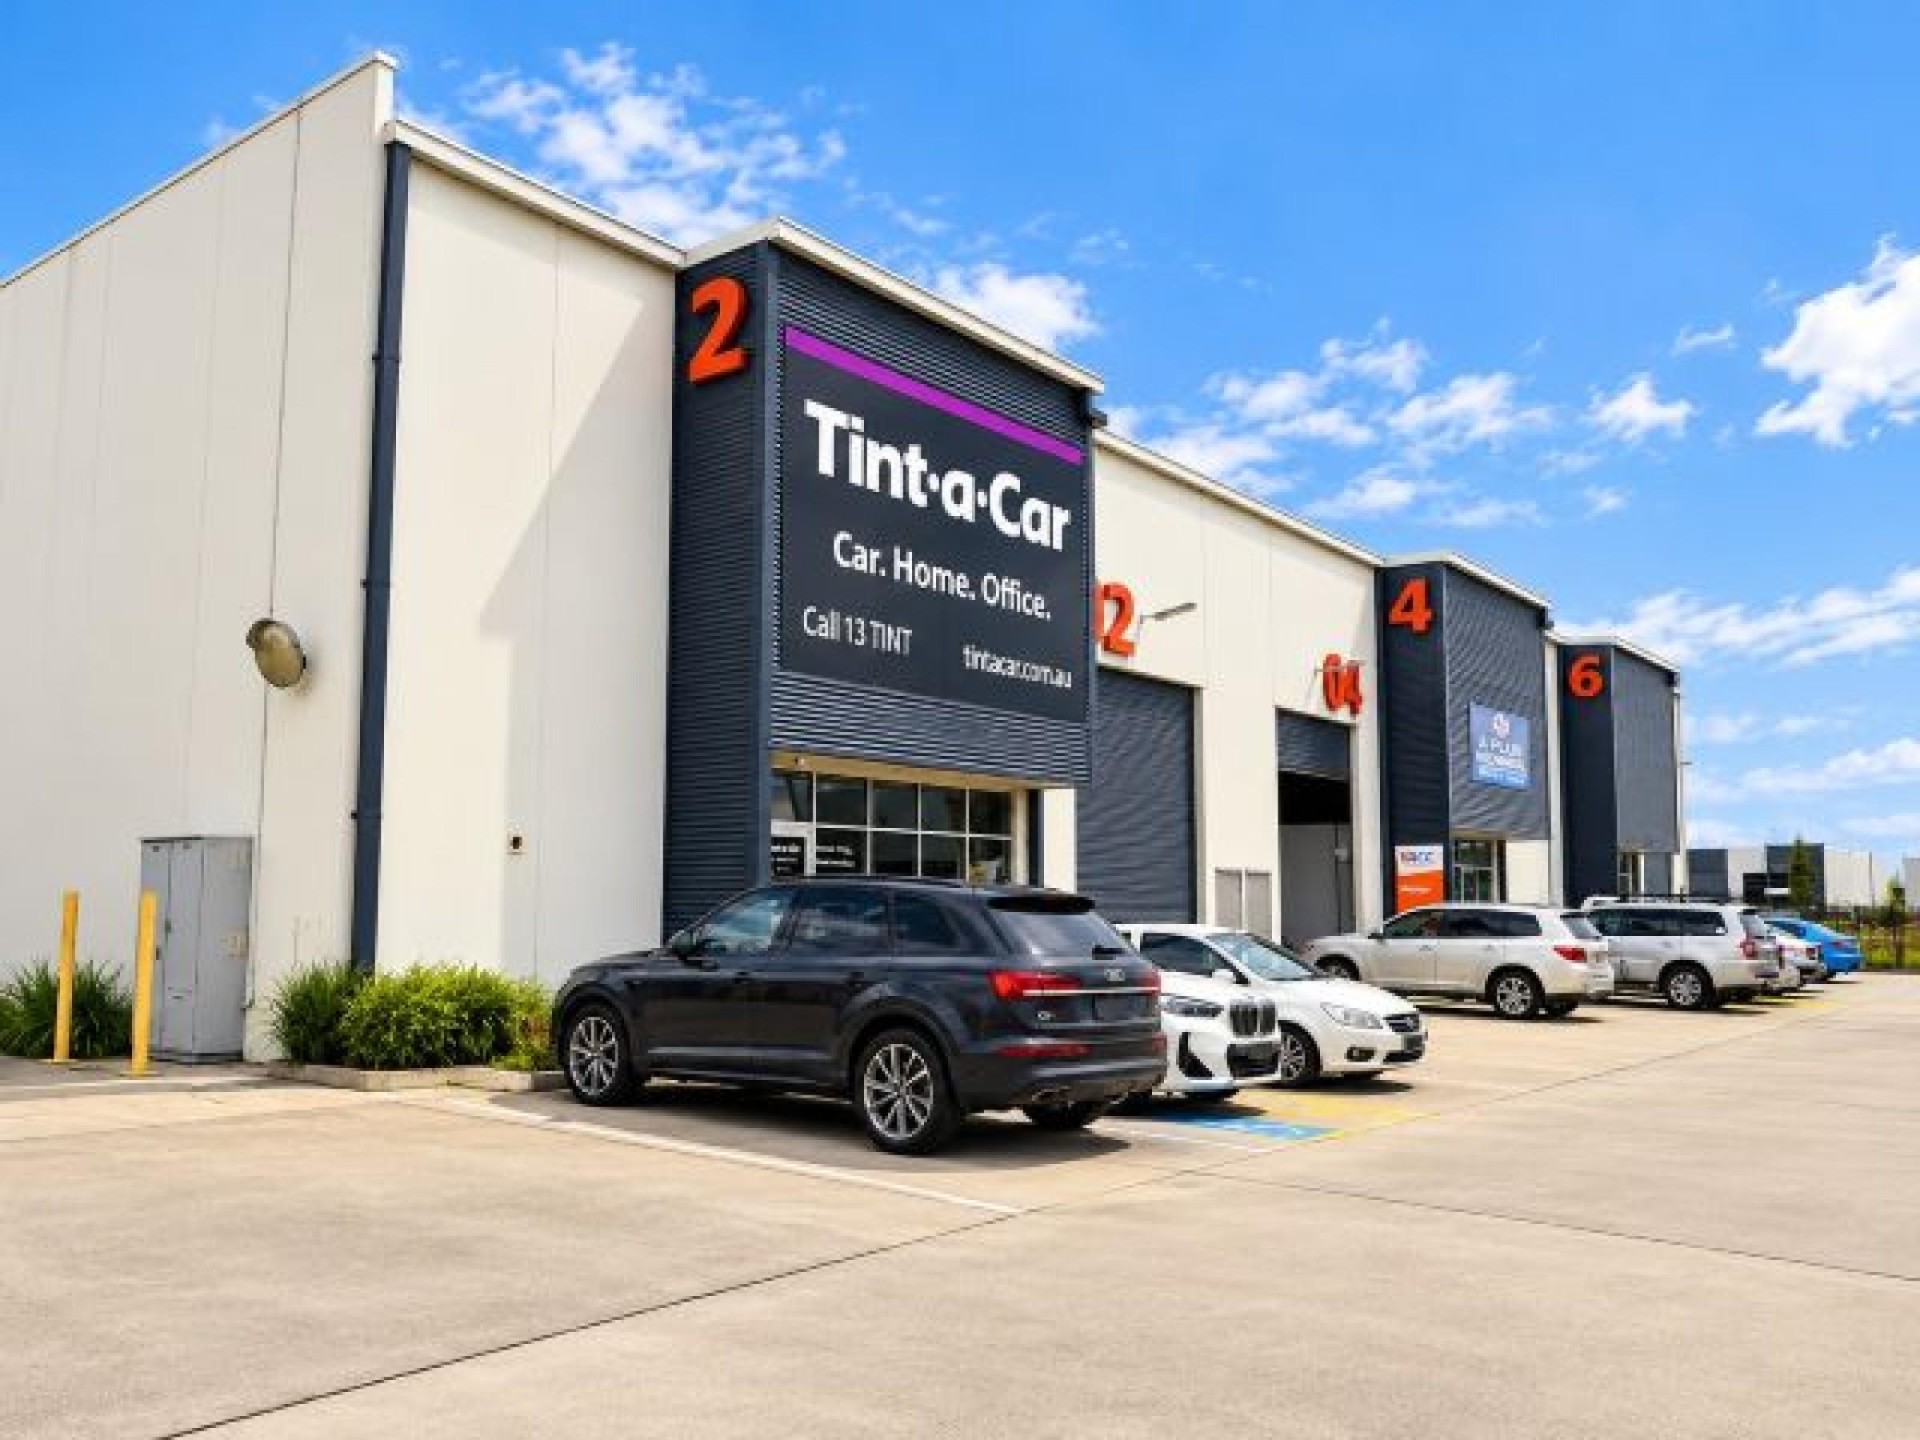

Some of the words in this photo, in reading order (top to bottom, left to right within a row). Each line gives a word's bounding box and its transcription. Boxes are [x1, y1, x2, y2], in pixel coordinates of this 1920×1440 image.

[689, 277, 745, 383] 2
[833, 531, 886, 577] Car.
[893, 546, 976, 600] Home.
[981, 573, 1051, 621] Office.
[804, 606, 840, 641] Call
[846, 617, 865, 646] 13
[869, 620, 912, 655] TINT
[1388, 577, 1433, 635] 4
[962, 644, 1072, 688] tintacar.com.au
[1567, 654, 1604, 697] 6
